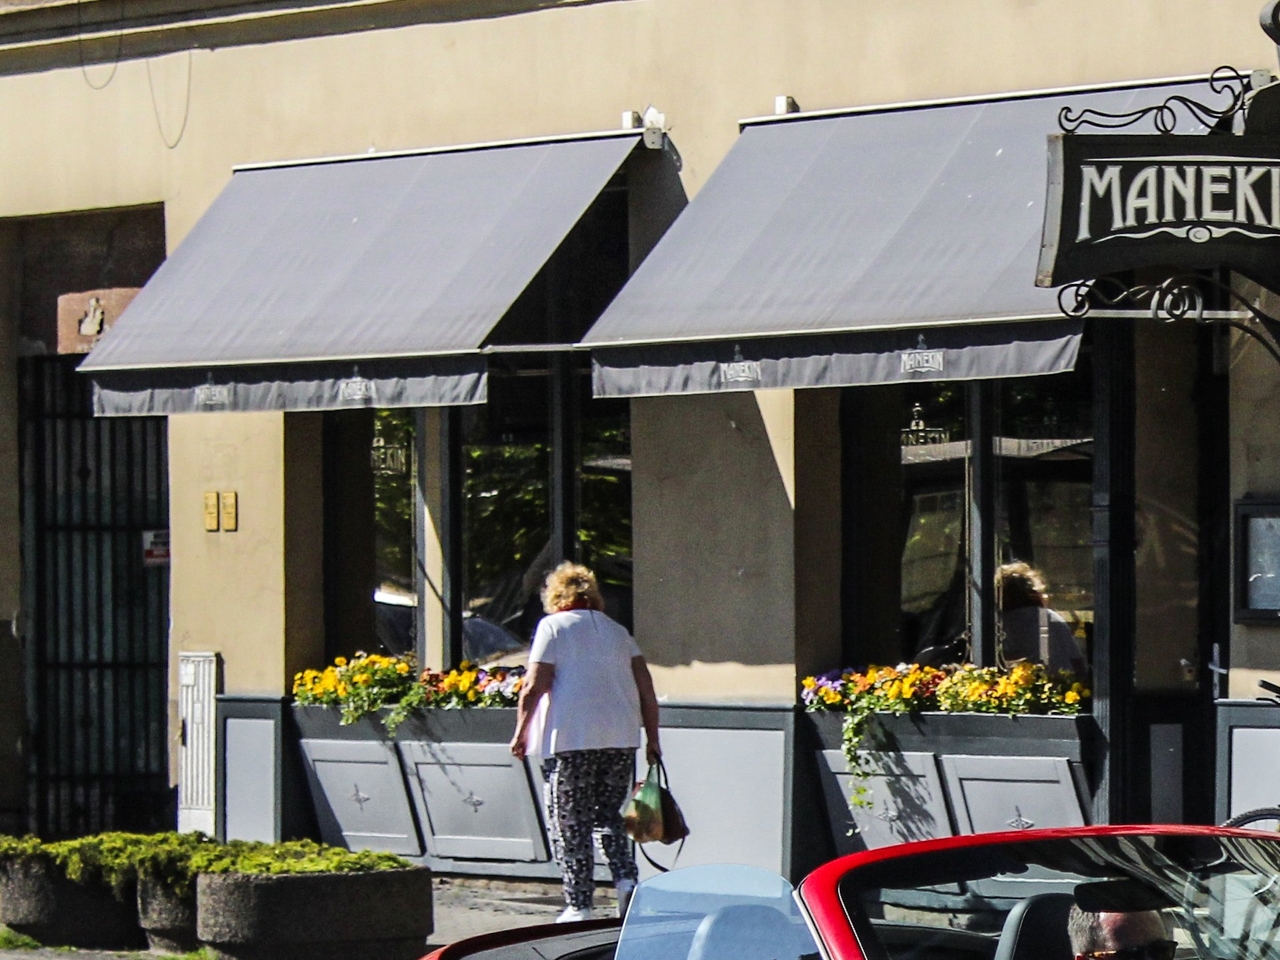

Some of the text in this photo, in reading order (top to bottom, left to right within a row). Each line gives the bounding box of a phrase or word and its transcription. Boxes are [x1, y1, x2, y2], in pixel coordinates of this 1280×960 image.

[900, 350, 944, 373] MANEKIN
[720, 362, 762, 382] MANEKIN
[901, 431, 950, 446] ANEKIN
